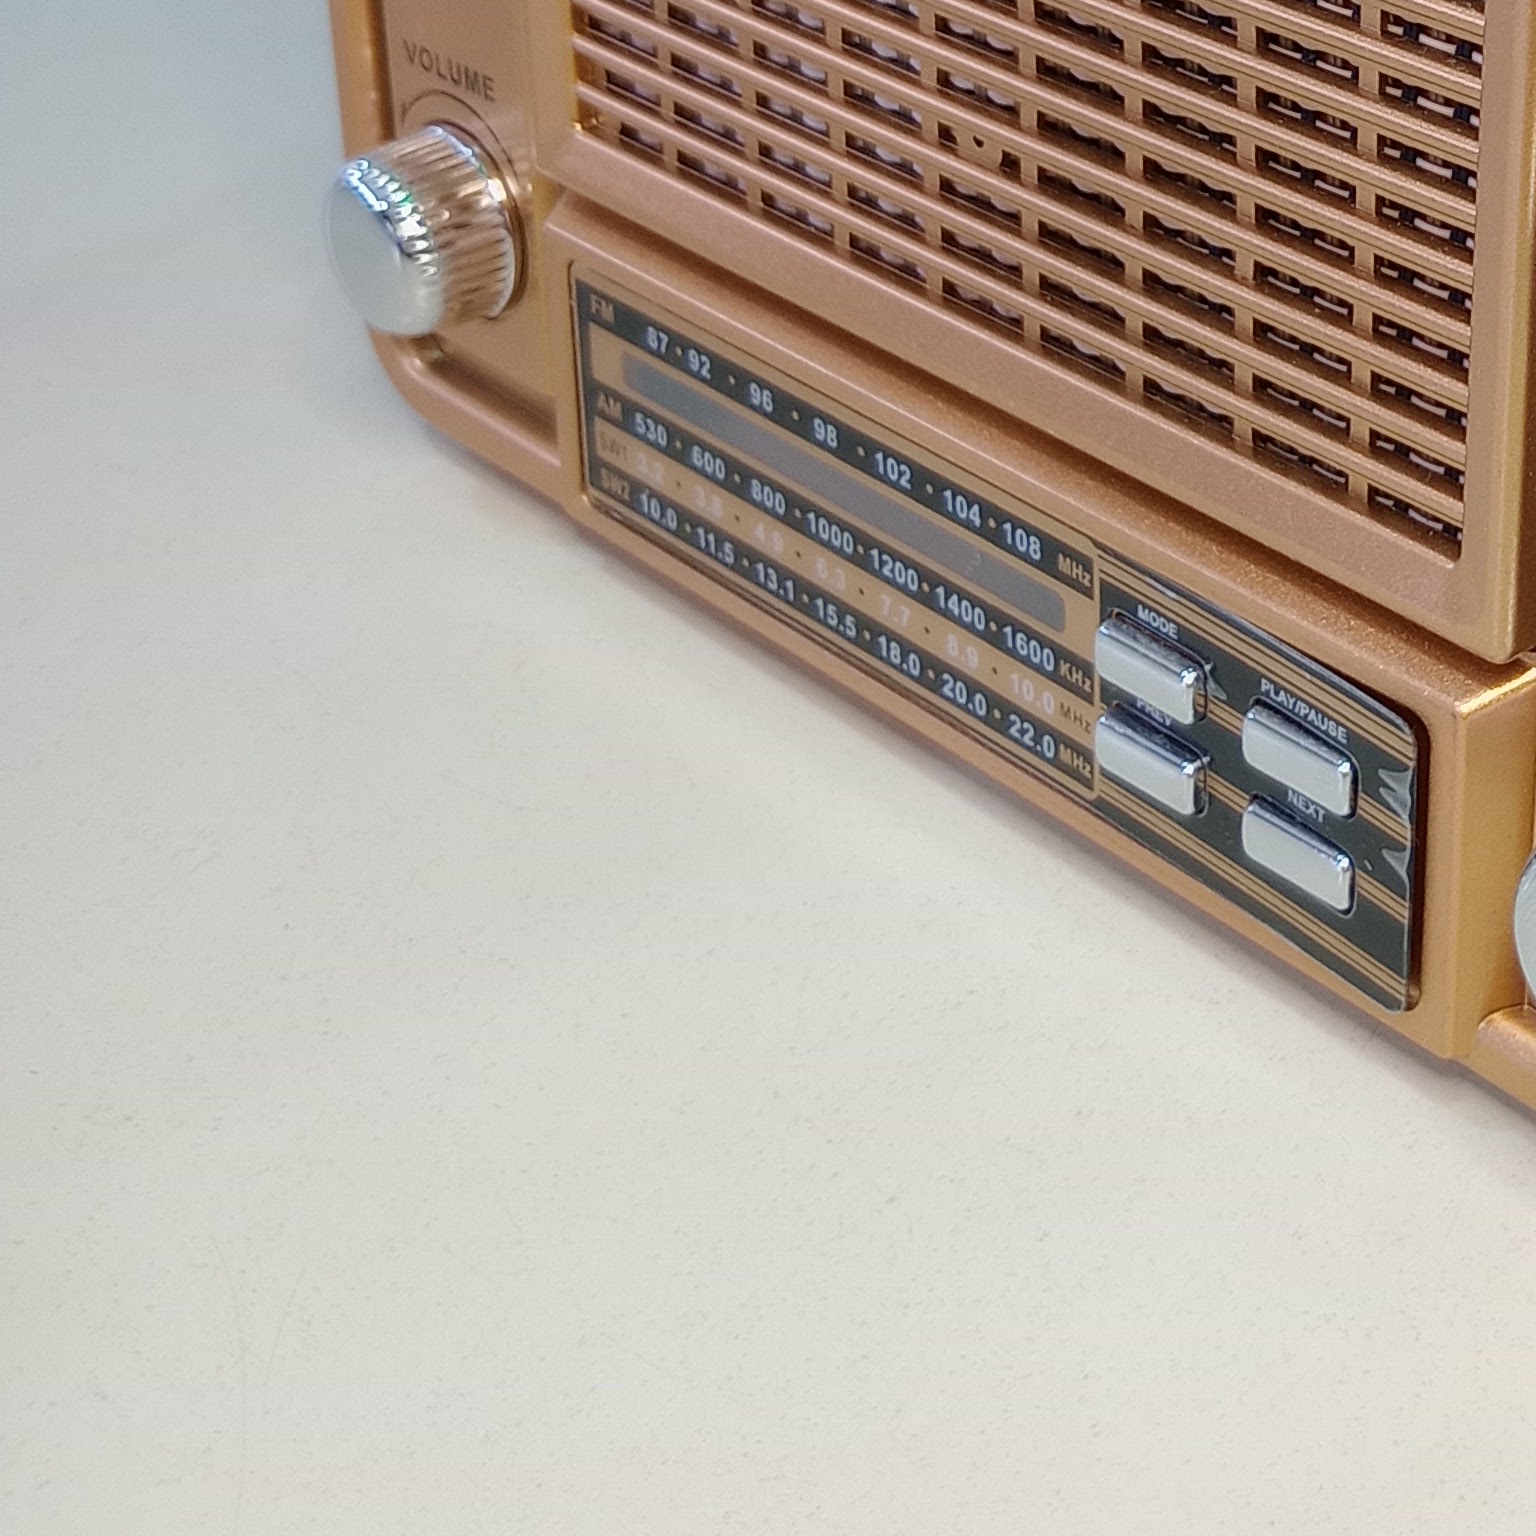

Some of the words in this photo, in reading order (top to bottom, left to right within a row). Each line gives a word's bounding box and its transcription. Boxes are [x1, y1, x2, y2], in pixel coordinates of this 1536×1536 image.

[403, 39, 497, 103] VOLUME
[590, 294, 616, 324] FM
[688, 348, 712, 380] 92
[749, 382, 774, 413] 96
[813, 417, 838, 448] 98
[874, 451, 912, 490] 102
[942, 488, 982, 528] 104
[1002, 521, 1042, 561] 108
[1058, 552, 1092, 588] MHz
[597, 391, 623, 421] AM
[634, 411, 668, 447] 530
[691, 445, 726, 480] 600
[750, 478, 786, 515] 800
[806, 512, 854, 556] 1000
[869, 548, 919, 592] 1200
[934, 585, 986, 631] 1400
[1002, 624, 1056, 672] 1600
[1060, 659, 1092, 693] KHz
[638, 489, 678, 531] 10.0
[696, 527, 735, 566] 11.5
[755, 562, 794, 602] 13.1
[814, 598, 857, 639] 15.5
[877, 635, 921, 676] 18.0
[941, 672, 988, 716] 20.0
[1008, 714, 1056, 759] 22.0
[1060, 743, 1093, 778] MHz
[1137, 605, 1178, 641] MODE
[1009, 673, 1055, 714] 10.0
[1060, 701, 1092, 734] MHz
[1260, 677, 1348, 745] PLAY/PAUSE
[1287, 789, 1327, 824] NEXT
